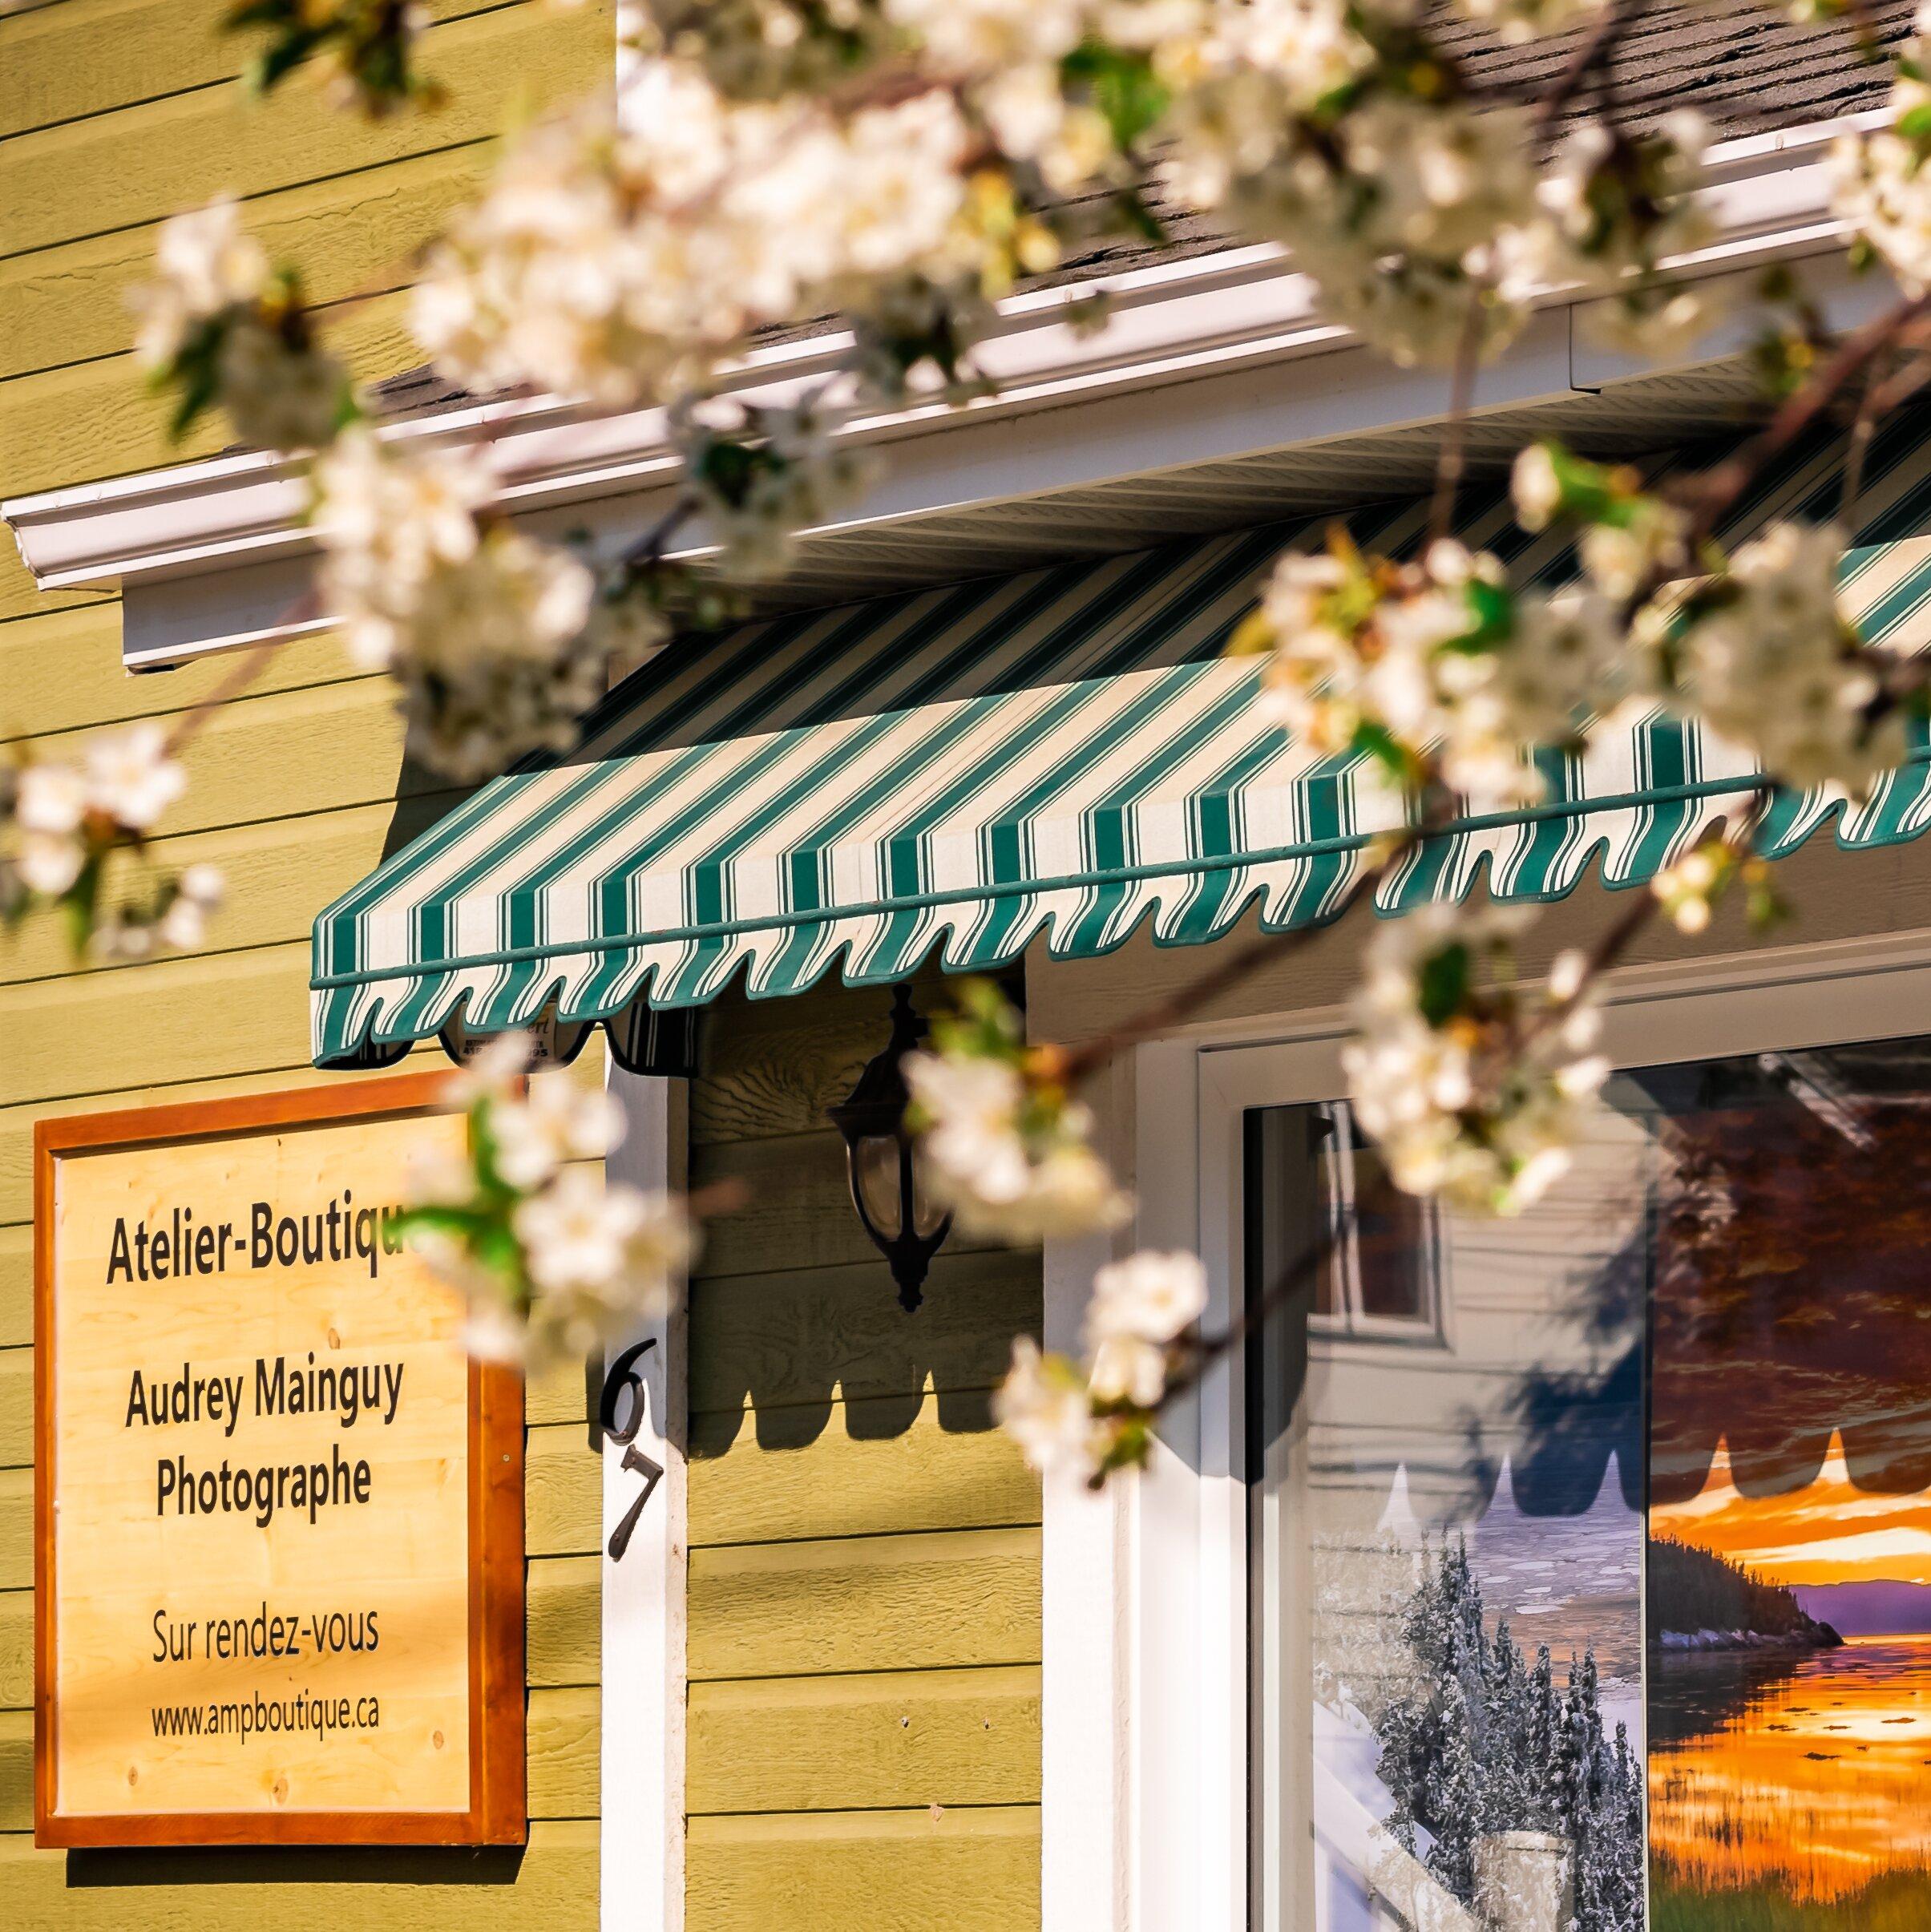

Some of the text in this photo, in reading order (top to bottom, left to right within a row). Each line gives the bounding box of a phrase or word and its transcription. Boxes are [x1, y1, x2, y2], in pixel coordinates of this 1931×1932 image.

[107, 1189, 425, 1284] Atelier-Boutiqu
[126, 1352, 404, 1437] Audrey Mainguy
[157, 1443, 371, 1529] Photographe
[600, 1337, 664, 1562] 67
[153, 1601, 379, 1663] Sur rendez-vous
[151, 1688, 379, 1745] www.ampboutique.ca
